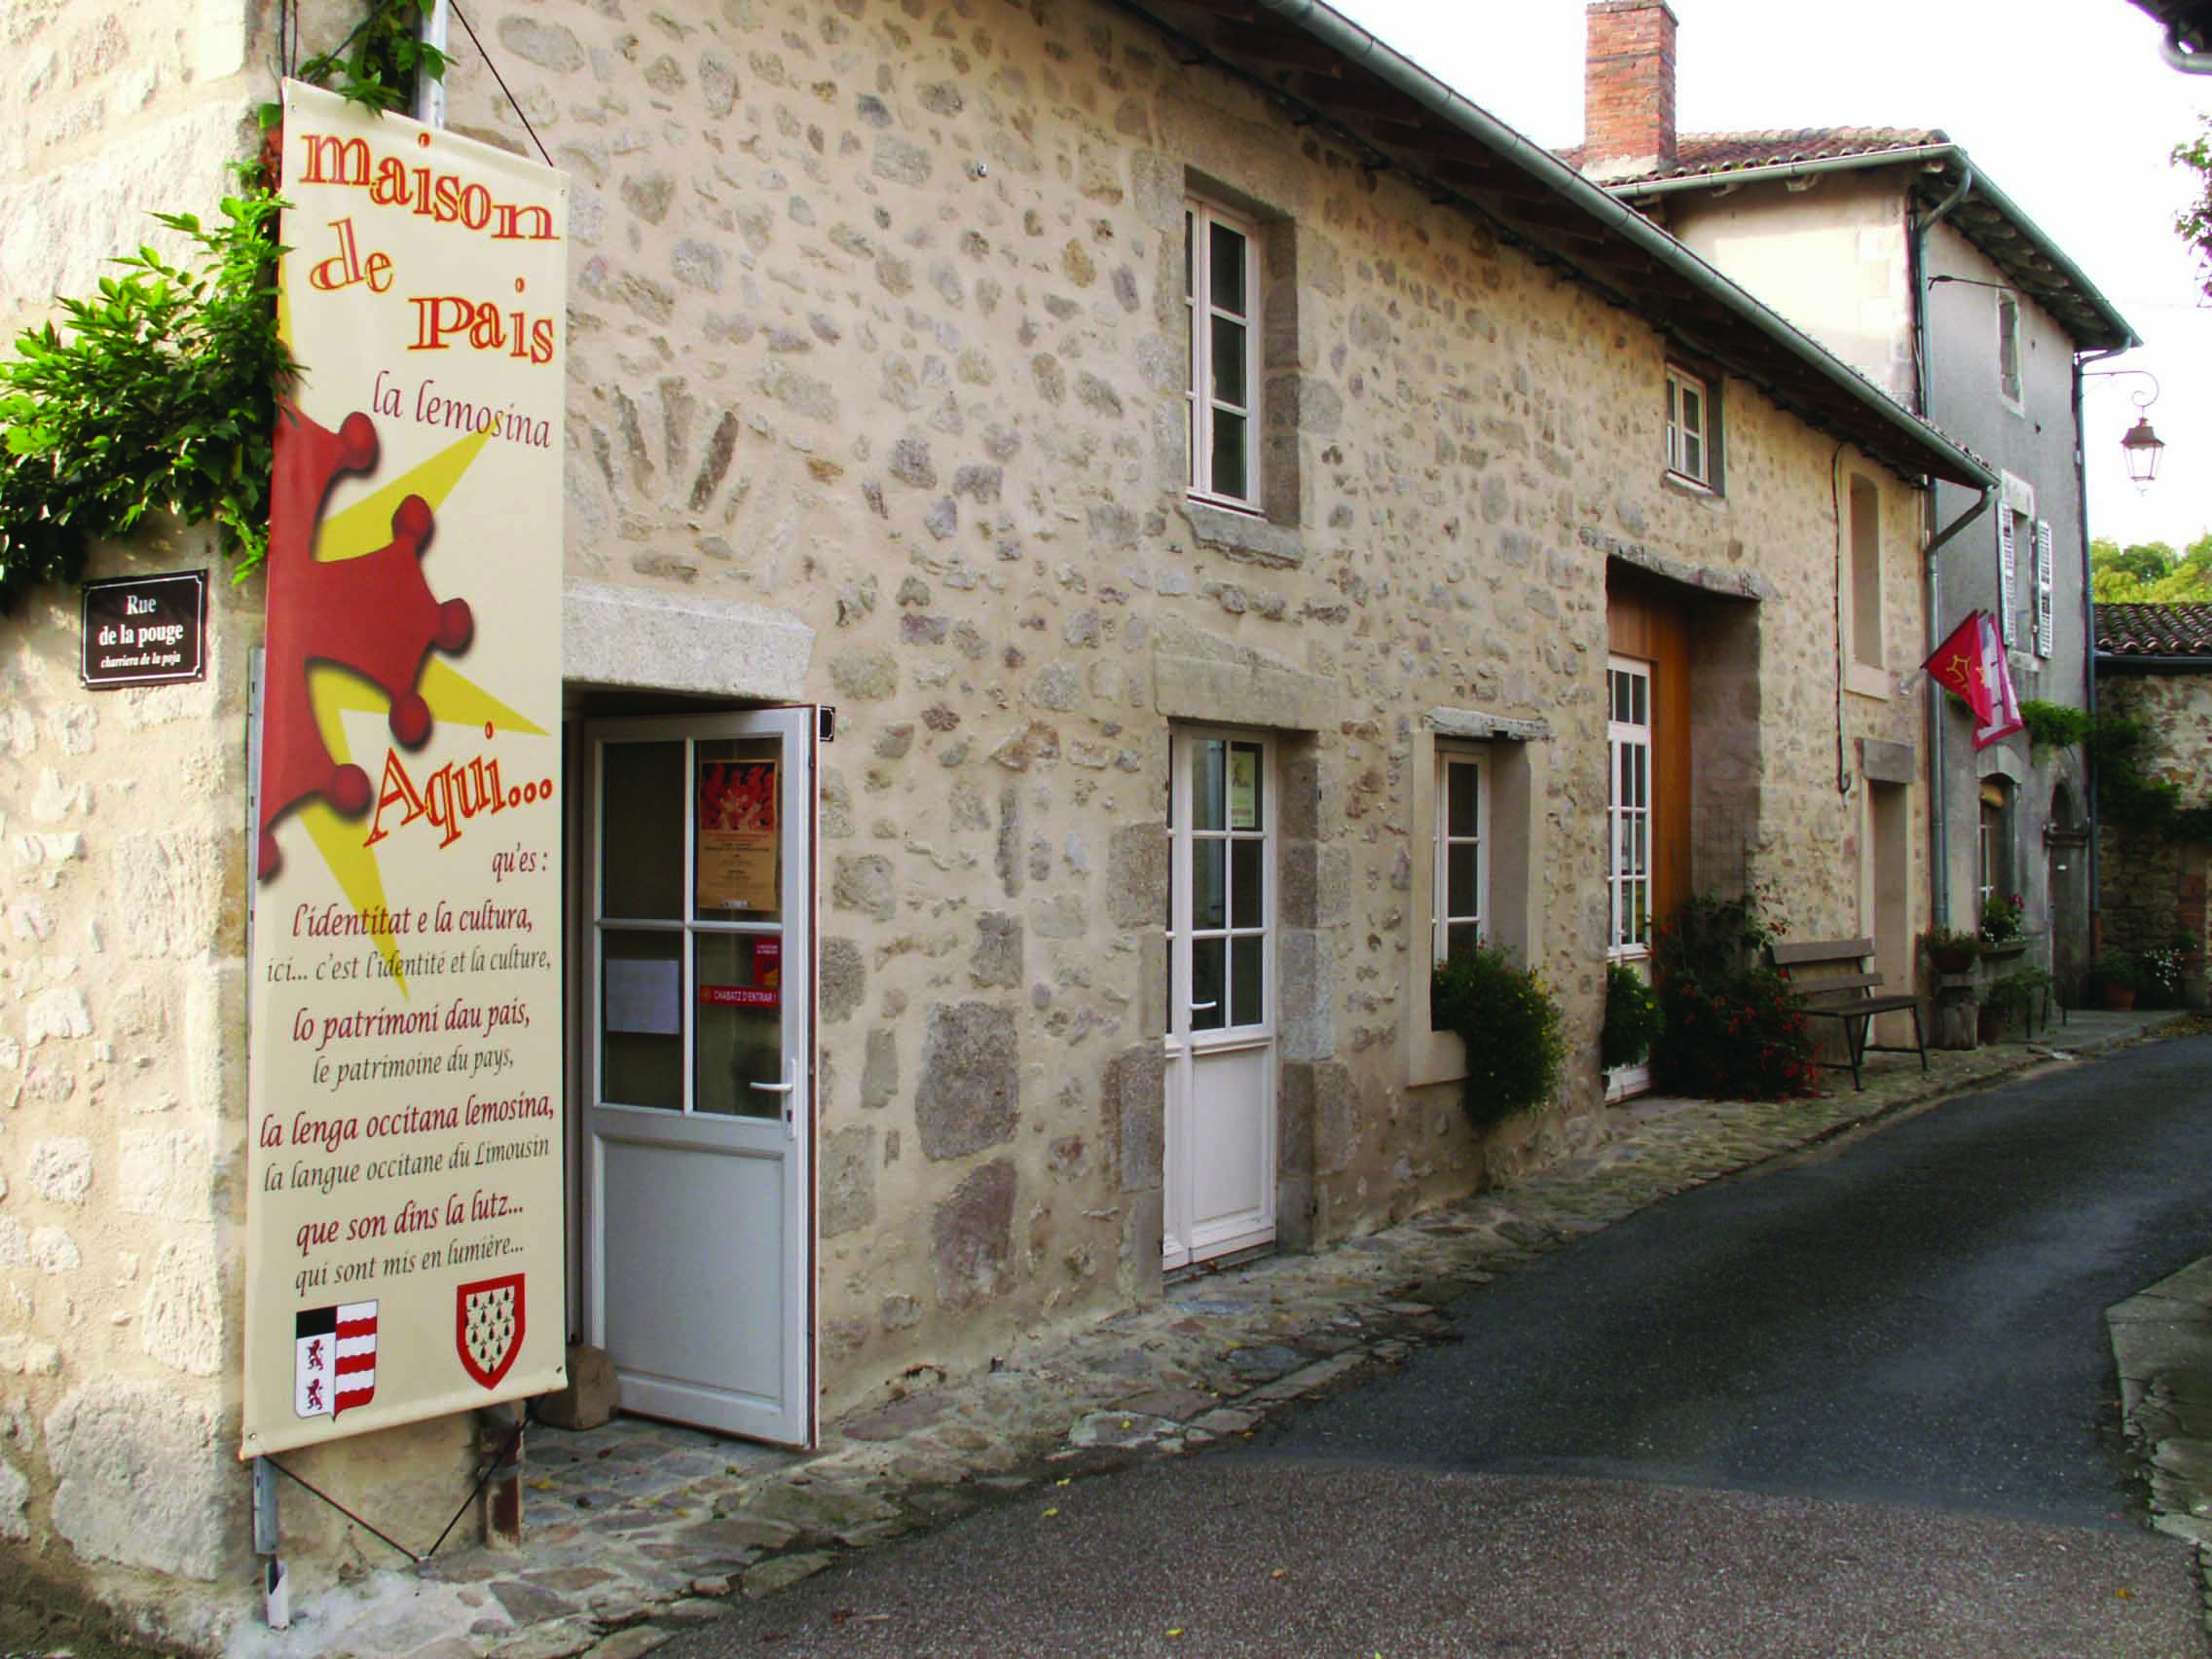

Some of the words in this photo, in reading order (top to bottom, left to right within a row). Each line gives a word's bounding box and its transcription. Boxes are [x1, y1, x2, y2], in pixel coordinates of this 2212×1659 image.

[299, 132, 560, 240] maison
[310, 217, 392, 292] de
[374, 371, 402, 417] la
[416, 380, 550, 449] lemosina
[126, 595, 157, 615] Rue
[98, 625, 117, 645] de
[120, 624, 134, 644] la
[137, 624, 184, 648] pouge
[362, 720, 553, 849] Aqui...
[292, 903, 410, 937] l'identitat
[418, 911, 427, 933] e
[434, 901, 452, 933] la
[459, 900, 534, 933] cultura,
[268, 957, 308, 982] ici...
[316, 953, 358, 980] c'est
[366, 949, 445, 979] l'identité
[451, 953, 464, 975] et
[470, 945, 485, 974] la
[490, 943, 551, 972] culture,
[293, 1007, 313, 1042] lo
[315, 1004, 439, 1051] patrimoni
[445, 998, 482, 1032] dau
[483, 999, 530, 1038] pais,
[313, 1055, 329, 1084] le
[331, 1049, 440, 1091] patrimoine
[447, 1045, 467, 1073] du
[469, 1048, 513, 1079] pays,
[260, 1113, 282, 1149] la
[291, 1111, 359, 1153] lenga
[366, 1104, 459, 1138] occitana
[465, 1091, 554, 1126] lemosina,
[264, 1160, 283, 1193] la
[290, 1160, 359, 1195] langue
[366, 1151, 443, 1181] occitane
[448, 1142, 469, 1170] du
[474, 1137, 550, 1167] Limousin
[296, 1220, 339, 1257] que
[347, 1214, 386, 1241] son
[393, 1200, 438, 1235] dins
[445, 1193, 463, 1228] la
[471, 1189, 524, 1222] lutz...
[295, 1262, 328, 1298] qui
[334, 1258, 375, 1283] sont
[384, 1252, 415, 1276] mis
[422, 1247, 441, 1271] en
